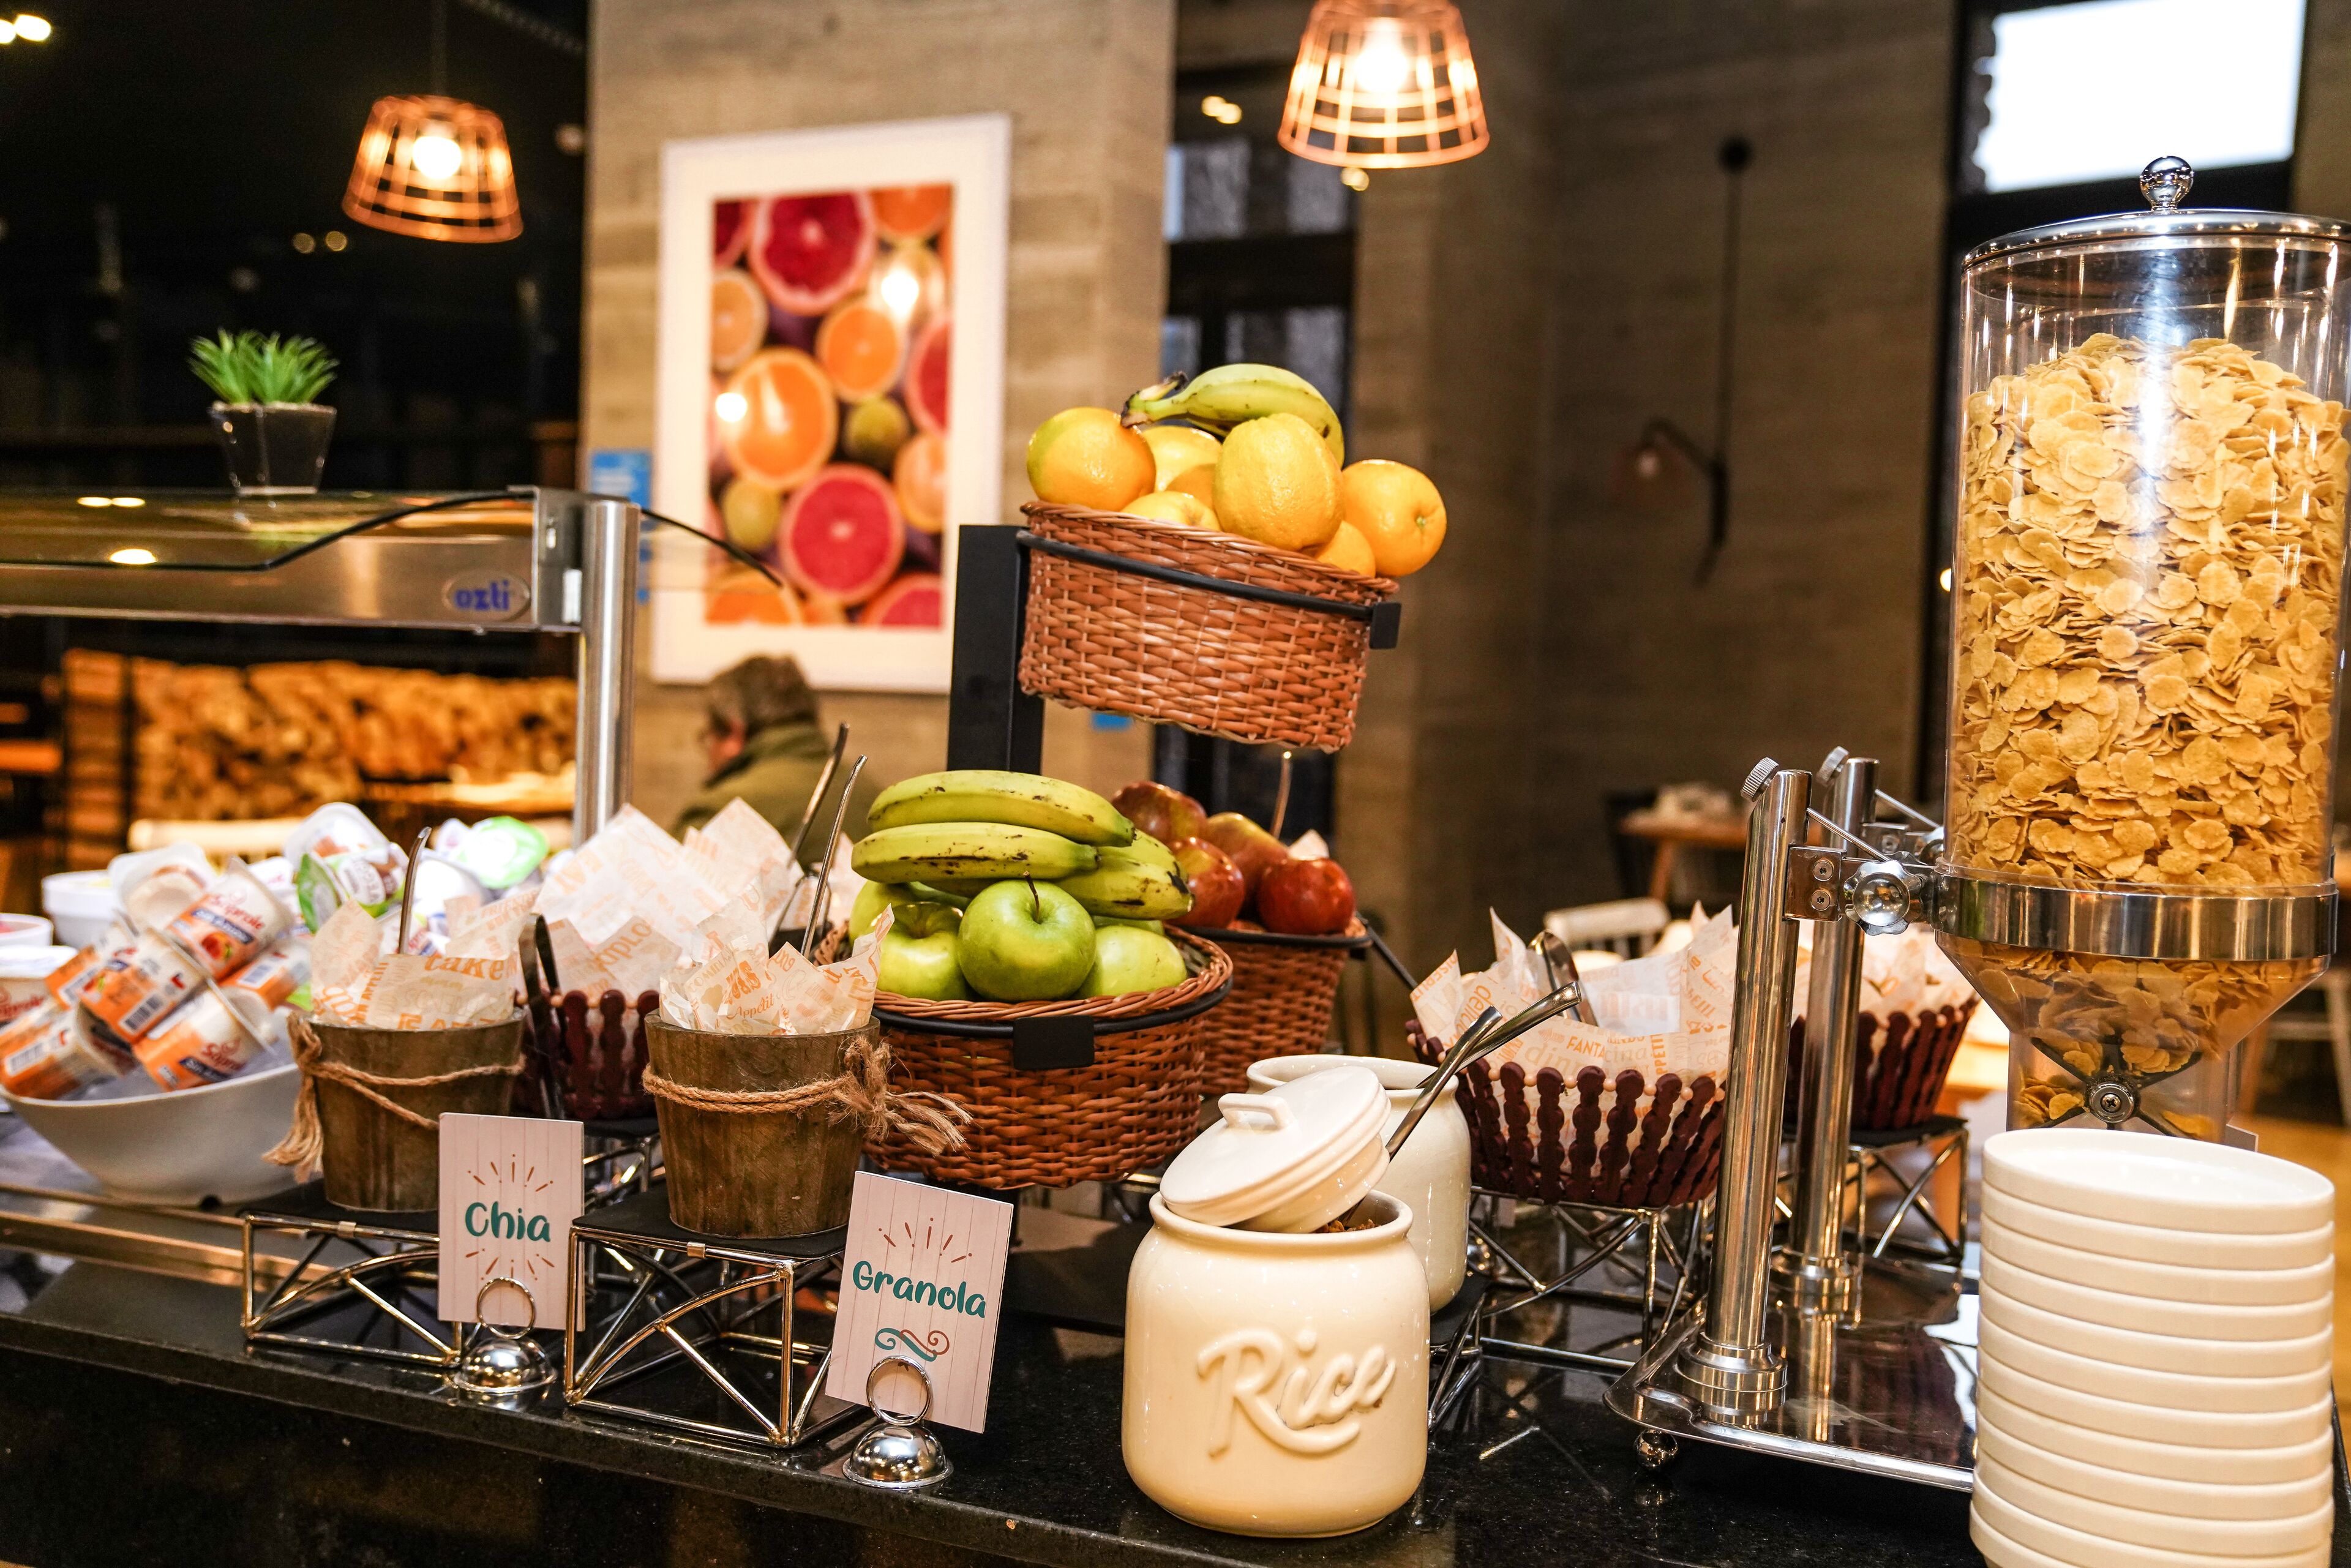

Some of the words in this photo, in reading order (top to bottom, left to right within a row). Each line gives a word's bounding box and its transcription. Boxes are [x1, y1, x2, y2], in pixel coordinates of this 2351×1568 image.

[465, 1201, 551, 1243] Chia
[852, 1261, 986, 1318] Granola
[1197, 1327, 1397, 1460] Rice
